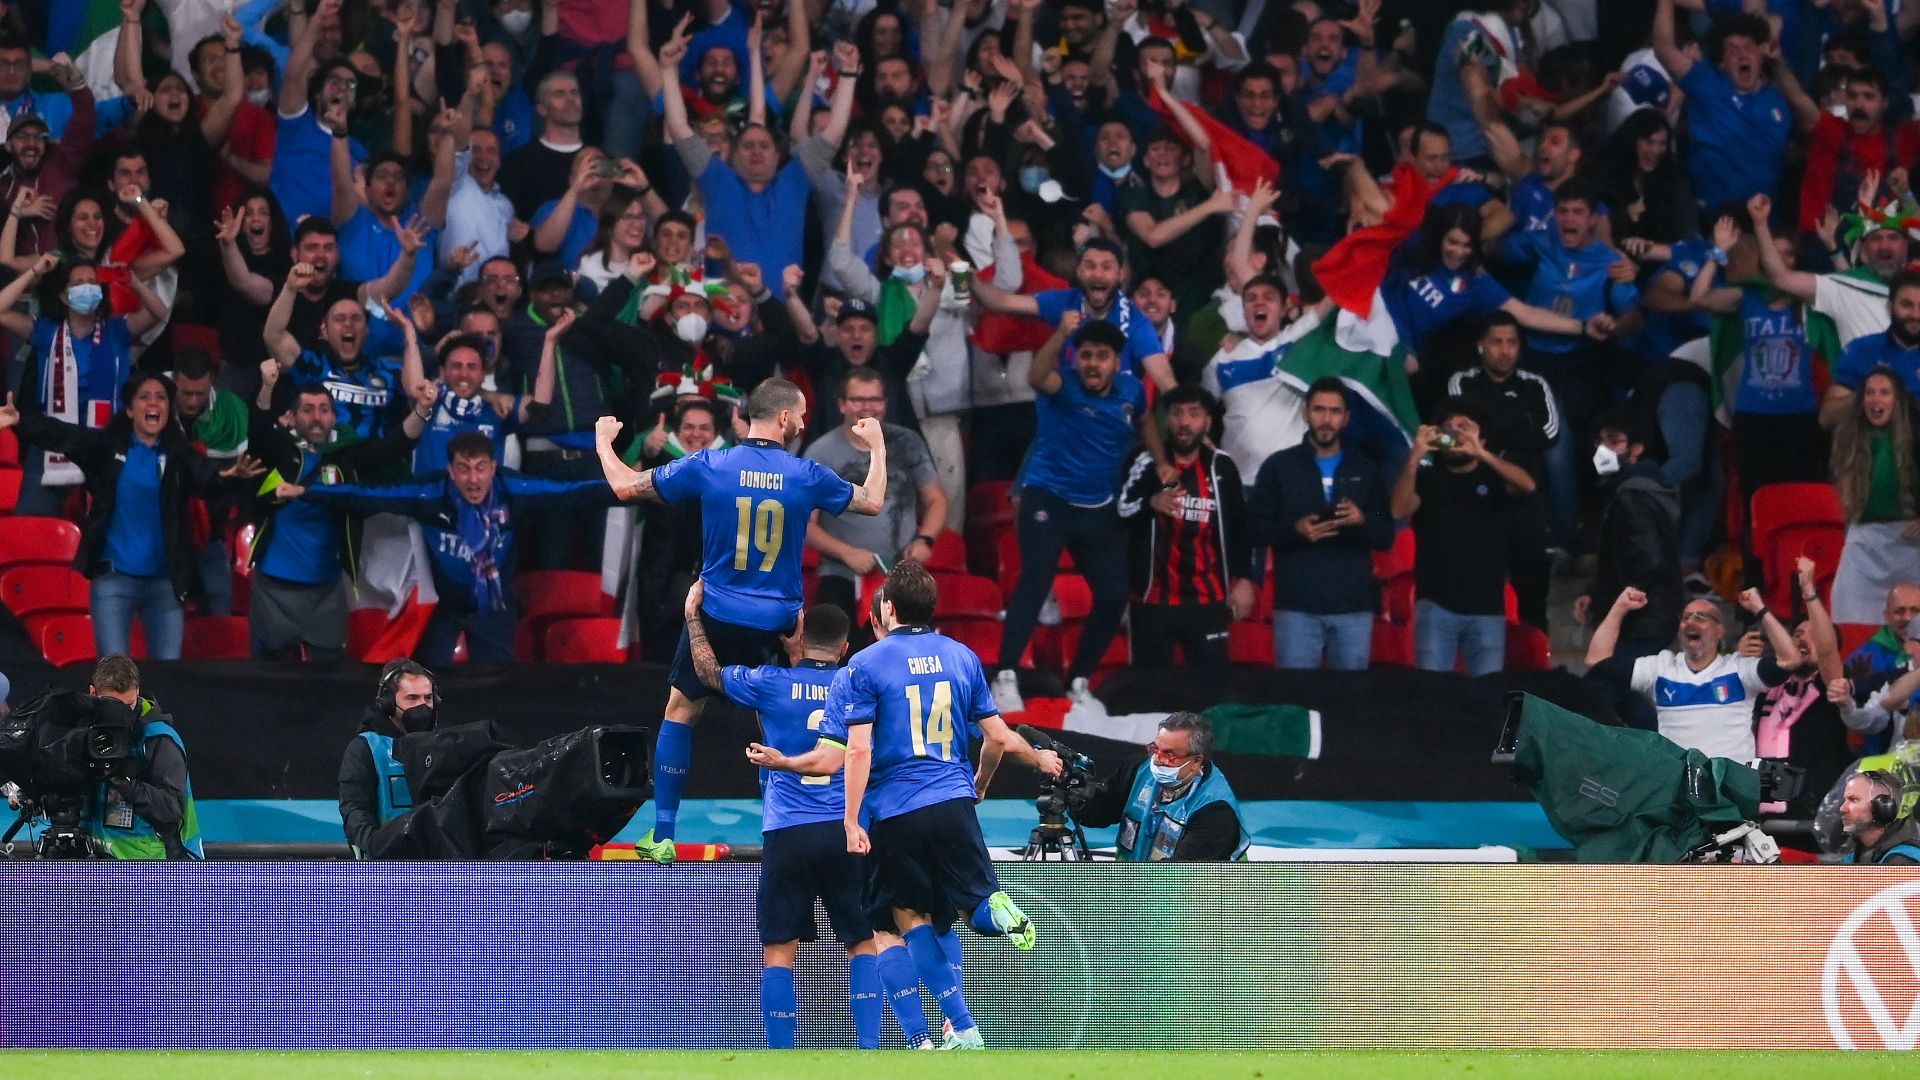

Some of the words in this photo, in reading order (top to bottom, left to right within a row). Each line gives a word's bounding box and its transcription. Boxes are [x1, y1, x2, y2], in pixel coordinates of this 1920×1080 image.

[739, 469, 784, 491] BONUCCI
[734, 496, 785, 572] 19
[907, 655, 943, 675] CHIESA
[791, 683, 802, 700] DI
[905, 680, 954, 761] 14
